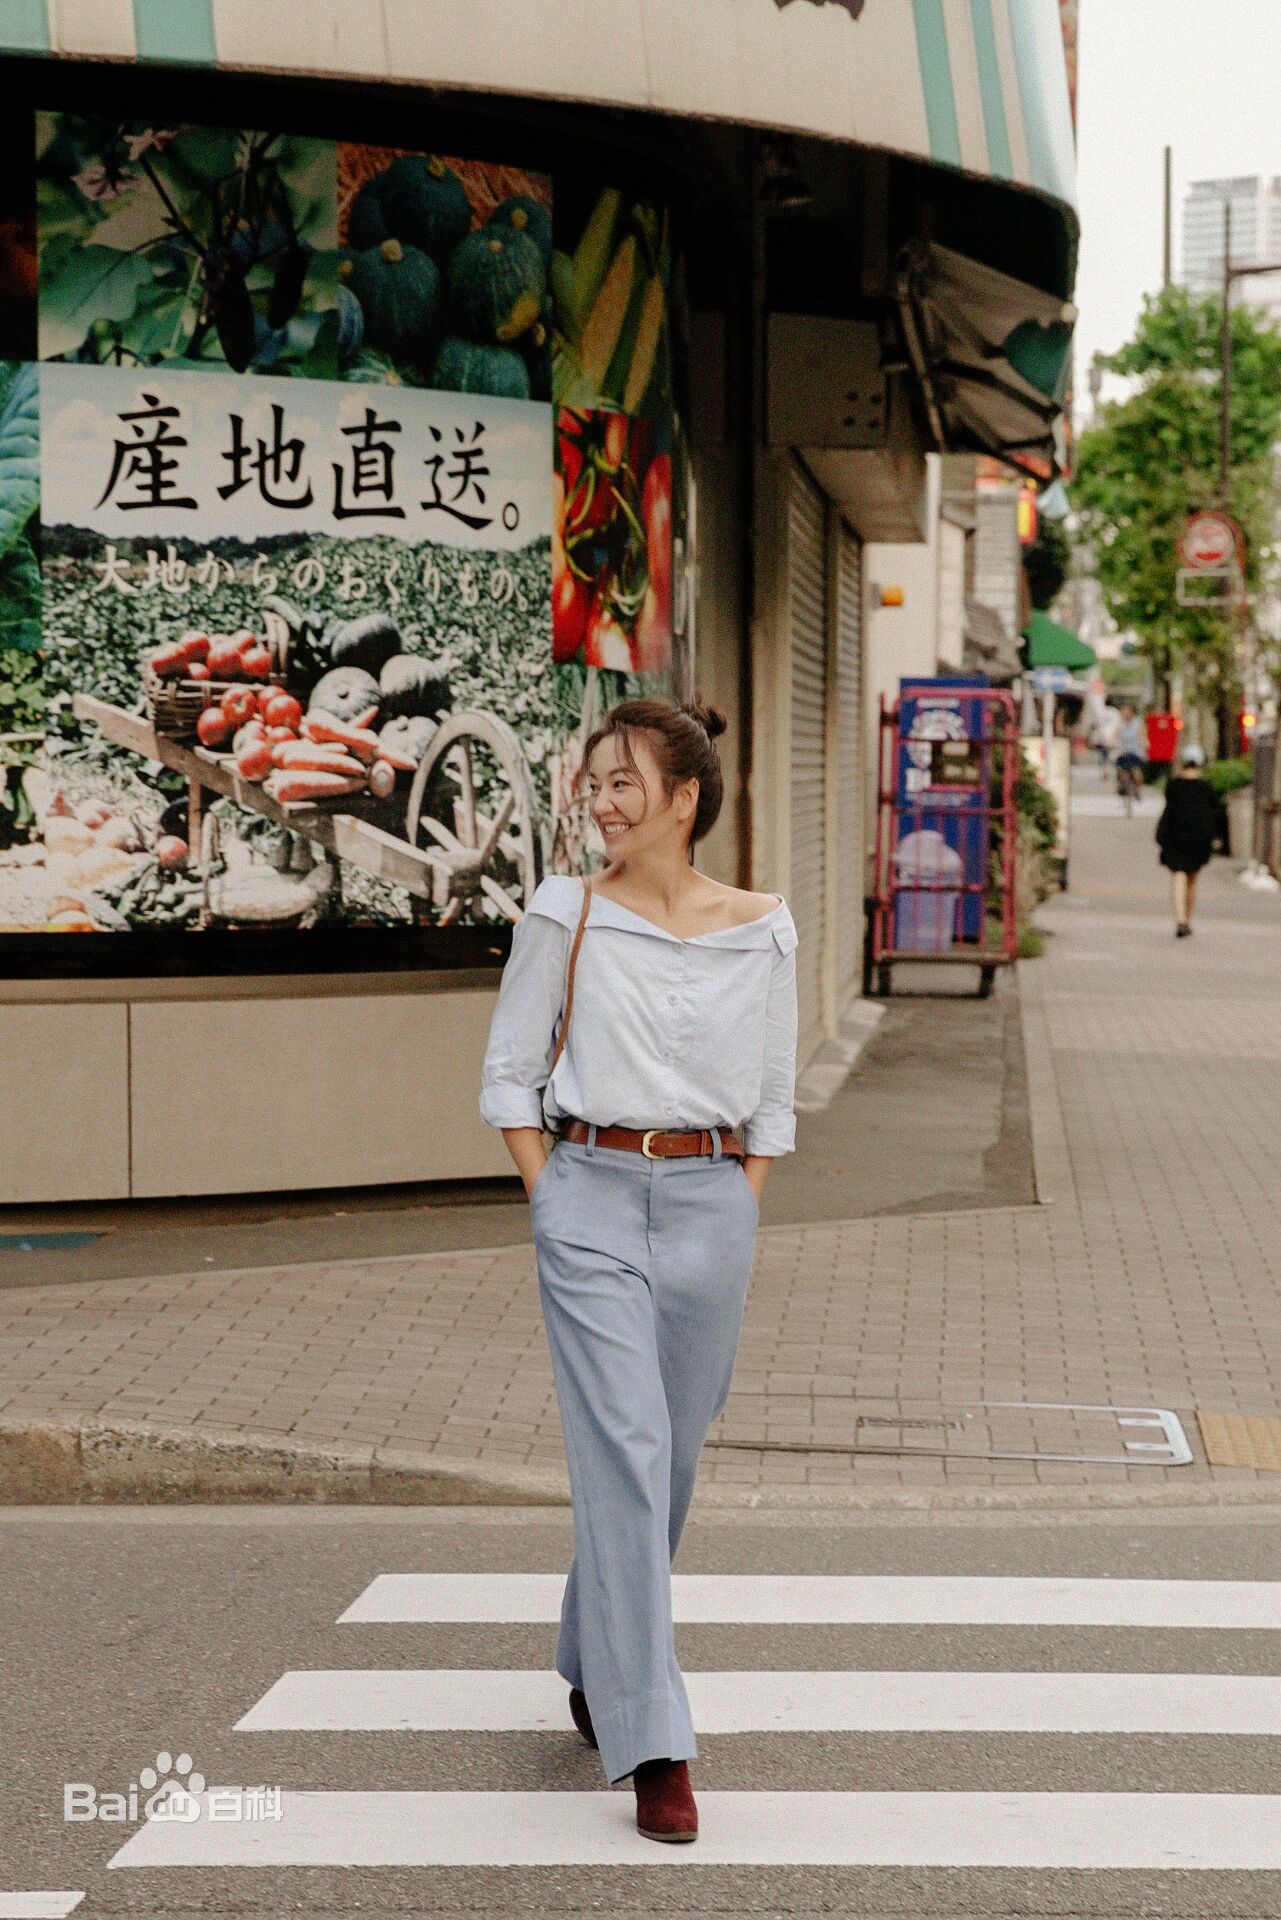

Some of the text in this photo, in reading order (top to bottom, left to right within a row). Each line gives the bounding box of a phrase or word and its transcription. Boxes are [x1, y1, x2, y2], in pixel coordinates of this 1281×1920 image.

[95, 393, 520, 531] 産地直送。
[94, 545, 530, 613] 大地からのおくりもの。
